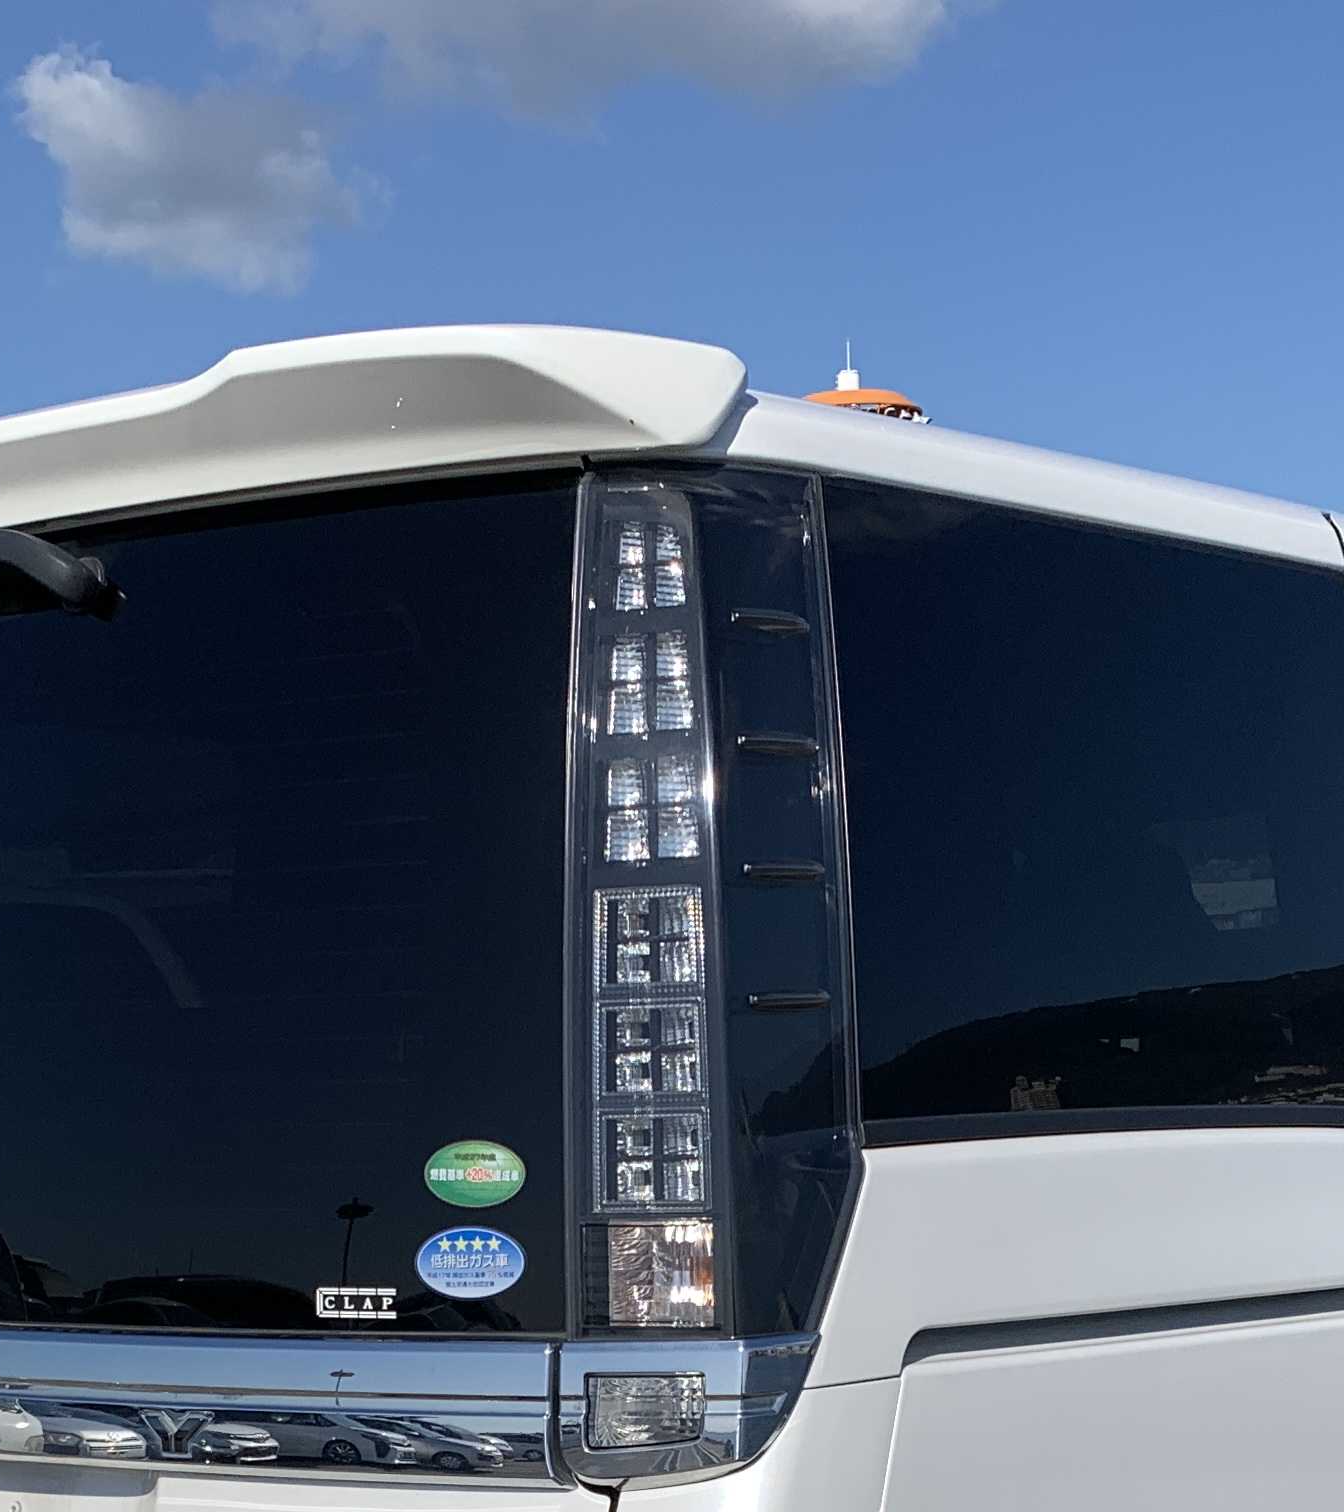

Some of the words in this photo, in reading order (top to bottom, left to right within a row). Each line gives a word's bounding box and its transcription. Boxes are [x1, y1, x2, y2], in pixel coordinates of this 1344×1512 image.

[431, 1253, 508, 1269] 低排出ガス車
[324, 1296, 394, 1310] CLAP
